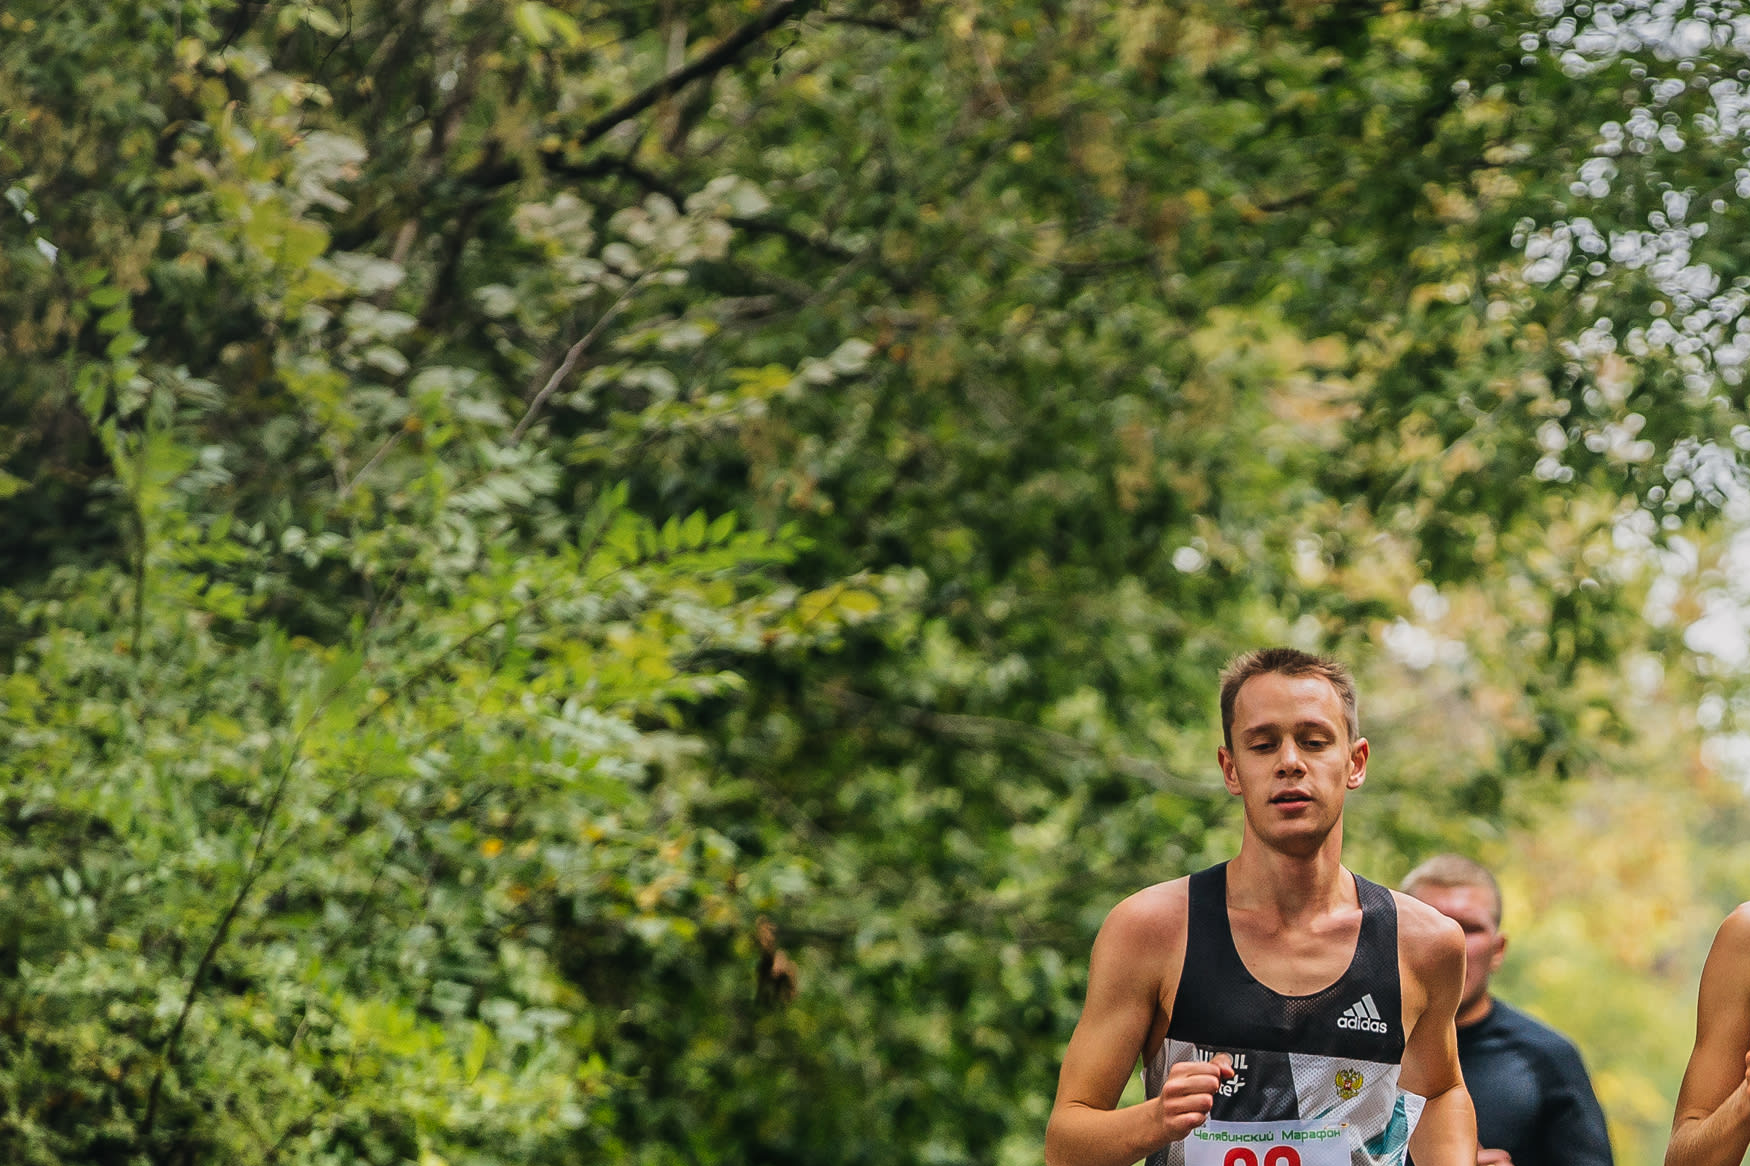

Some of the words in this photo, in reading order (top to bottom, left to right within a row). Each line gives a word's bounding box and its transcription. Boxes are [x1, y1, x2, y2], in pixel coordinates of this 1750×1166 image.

[1337, 1015, 1388, 1034] adidas
[1193, 1129, 1274, 1142] Челябинский
[1281, 1129, 1341, 1143] Марафон
